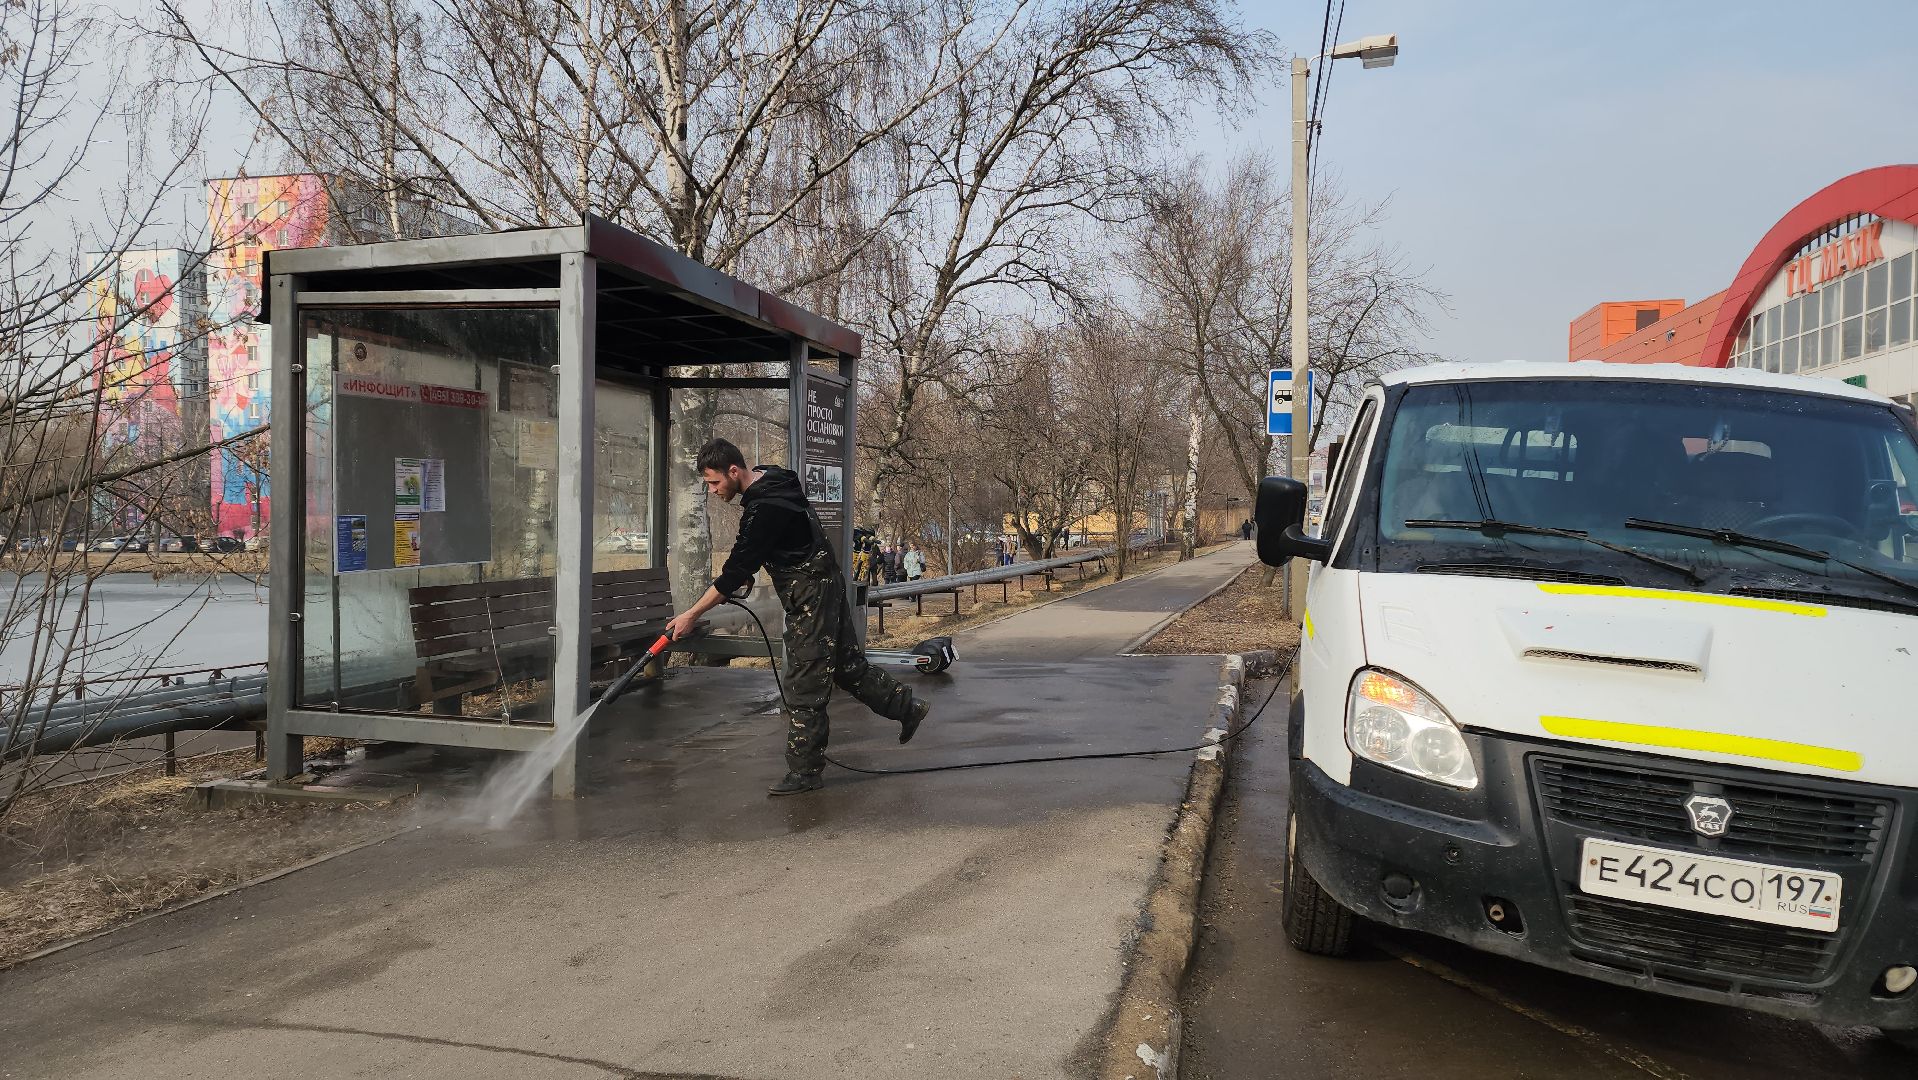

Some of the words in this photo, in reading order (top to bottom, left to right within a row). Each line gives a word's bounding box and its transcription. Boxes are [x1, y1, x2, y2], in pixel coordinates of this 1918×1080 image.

[1819, 220, 1885, 284] МАЯК
[807, 389, 817, 404] НЕ
[807, 404, 833, 421] ПРОСТО
[1598, 855, 1756, 904] Е424СО
[1767, 873, 1826, 904] 197
[1777, 901, 1808, 915] RUS
